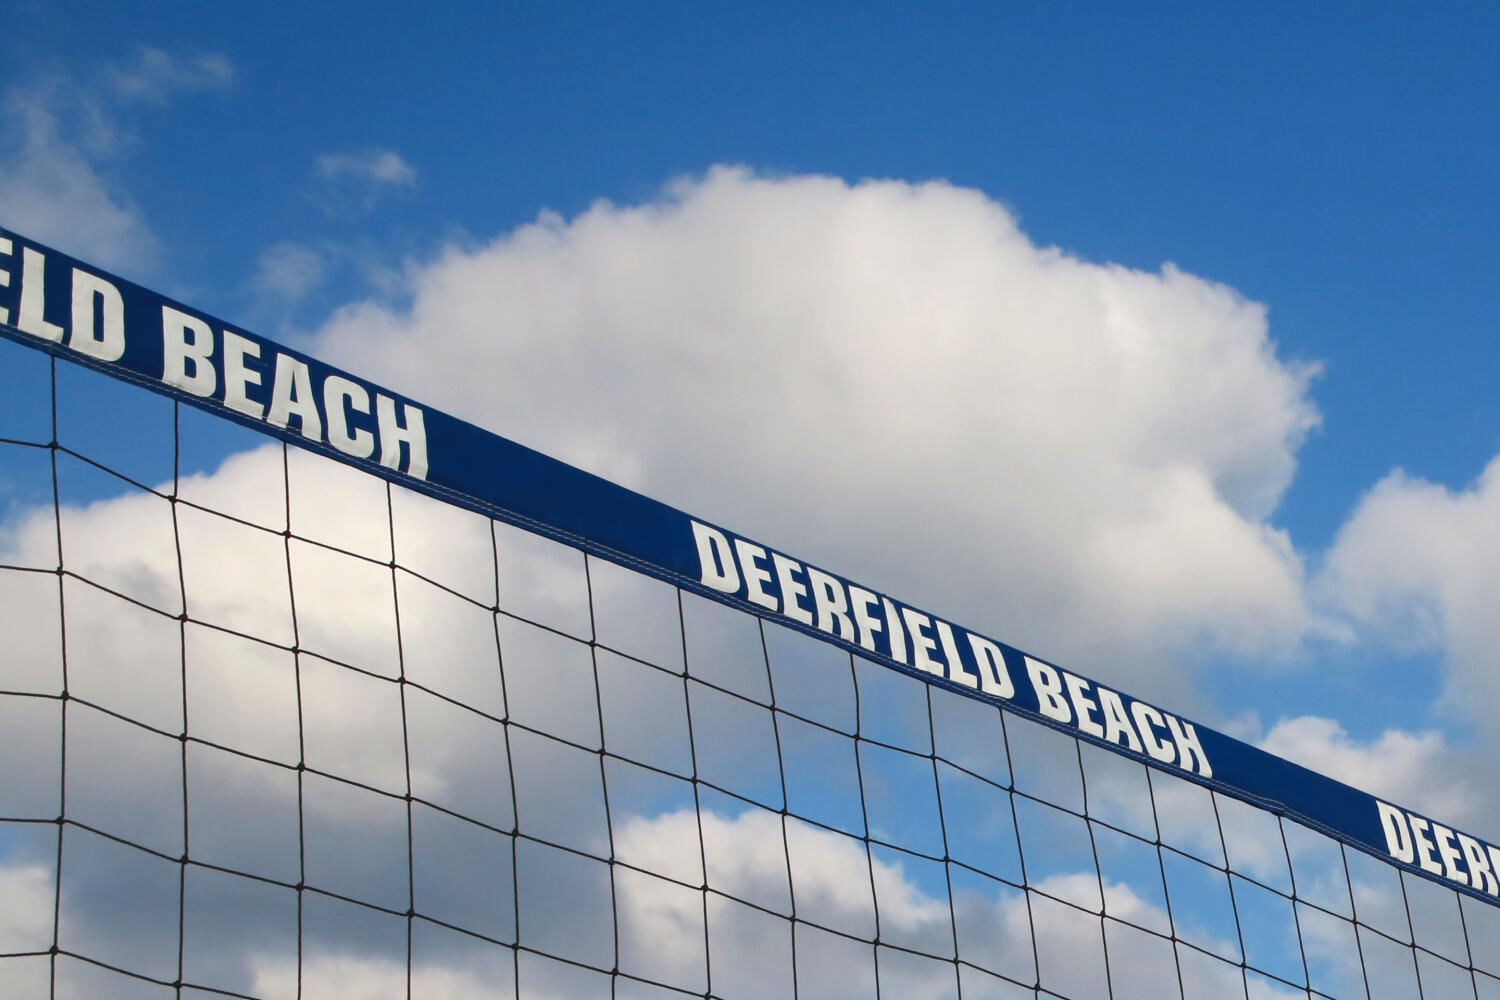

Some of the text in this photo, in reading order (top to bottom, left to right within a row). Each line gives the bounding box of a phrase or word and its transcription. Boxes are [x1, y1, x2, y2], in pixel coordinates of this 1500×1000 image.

[162, 306, 429, 481] BEACH
[691, 519, 1213, 779] DEERFIELD BEACH
